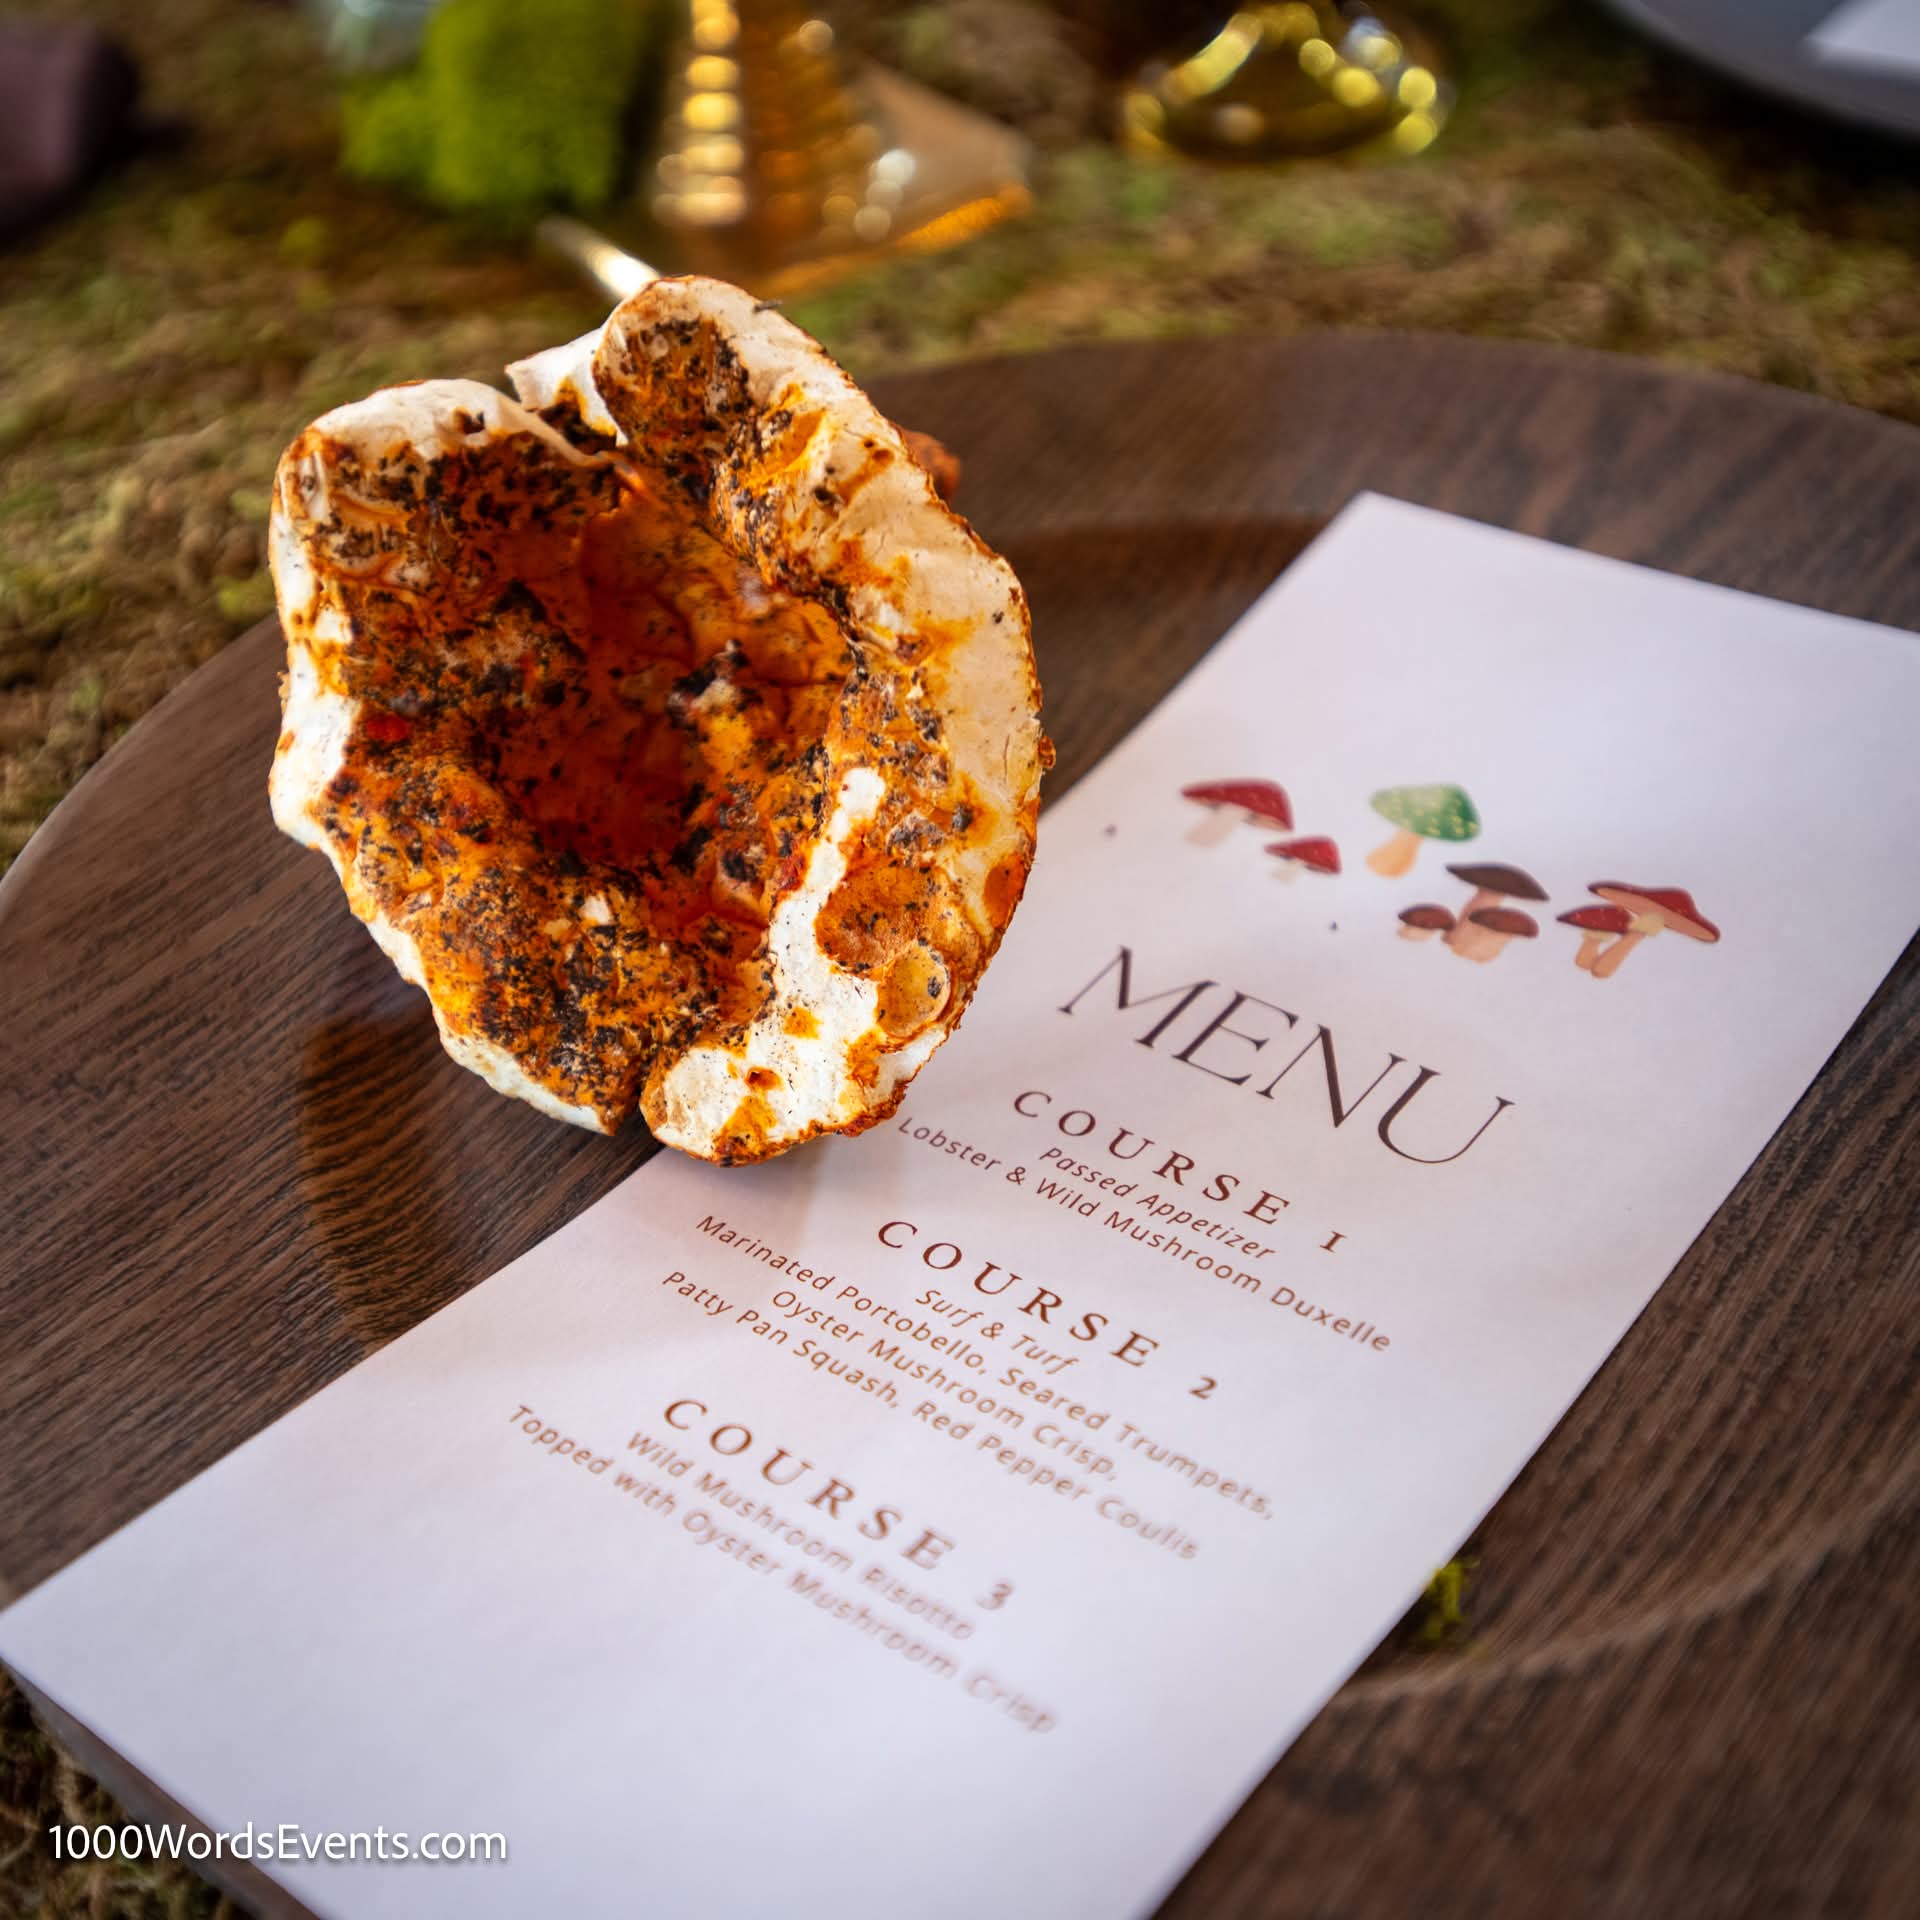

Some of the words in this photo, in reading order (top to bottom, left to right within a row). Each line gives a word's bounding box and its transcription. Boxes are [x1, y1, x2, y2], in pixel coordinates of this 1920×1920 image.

[1013, 1090, 1290, 1225] COURSE
[1057, 946, 1515, 1164] MENU
[898, 1117, 1002, 1170] Lobster
[1005, 1166, 1026, 1186] &
[1036, 1177, 1101, 1218] Wild
[1104, 1211, 1262, 1293] Mushroom
[1269, 1286, 1390, 1351] Duxelle
[1038, 1147, 1139, 1198] Passed
[1136, 1194, 1276, 1259] Appetizer
[696, 1216, 836, 1291] Marinated
[836, 1285, 986, 1375] Portobello,
[998, 1367, 1112, 1430] Seared
[1117, 1422, 1272, 1520] Trumpets,
[773, 1291, 864, 1343] Oyster
[867, 1338, 1024, 1429] Mushroom
[1033, 1423, 1117, 1482] Crisp,
[878, 1221, 1160, 1368] COURSE
[1188, 1376, 1218, 1400] 2
[915, 1290, 984, 1327] Surf
[980, 1322, 1004, 1341] &
[1011, 1334, 1080, 1375] Turf
[662, 1272, 734, 1316] Patty
[736, 1309, 788, 1344] Pan
[792, 1339, 898, 1408] Squash,
[912, 1400, 976, 1440] Red
[976, 1434, 1090, 1500] Pepper
[1096, 1496, 1198, 1559] Coulis
[663, 1398, 956, 1570] COURSE
[976, 1579, 1014, 1610] 3
[509, 1404, 614, 1474] Topped
[614, 1472, 676, 1516] with
[682, 1511, 781, 1574] Oyster
[789, 1570, 957, 1676] Mushroom
[968, 1673, 1055, 1731] Crisp
[627, 1432, 694, 1477] Wild
[696, 1472, 853, 1571] Mushroom
[860, 1565, 973, 1638] Risotto
